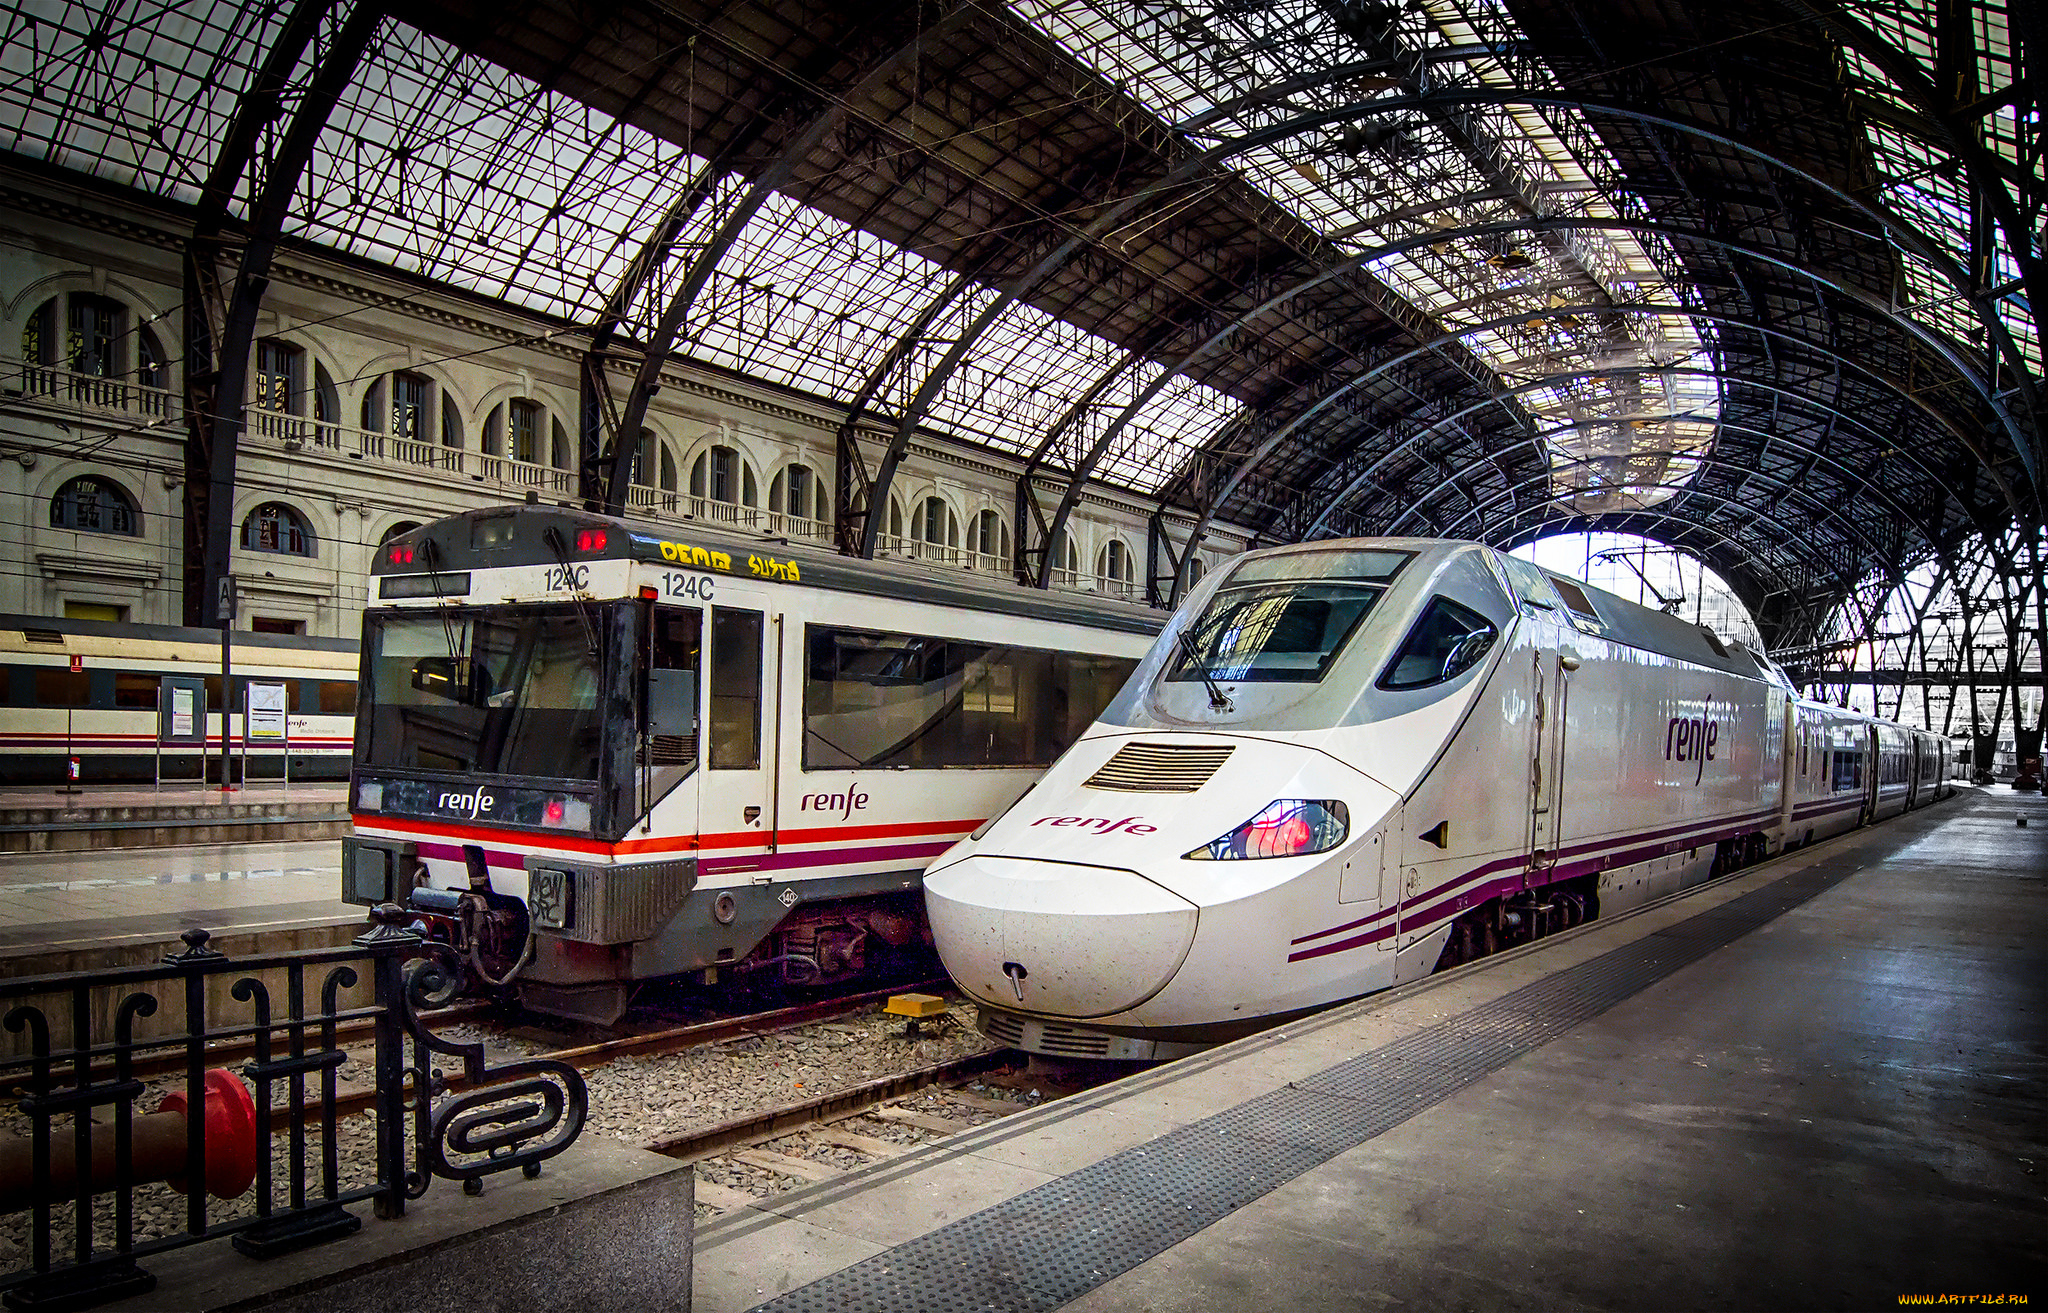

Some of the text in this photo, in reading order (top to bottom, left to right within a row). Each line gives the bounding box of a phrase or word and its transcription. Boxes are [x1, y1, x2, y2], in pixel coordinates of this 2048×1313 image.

[544, 565, 589, 591] 124C
[662, 571, 715, 601] 124C
[220, 582, 231, 604] A
[287, 720, 307, 728] enfe
[1666, 693, 1718, 787] renfe
[438, 785, 494, 820] renfe
[800, 782, 869, 822] renfe
[1030, 816, 1158, 836] renfe
